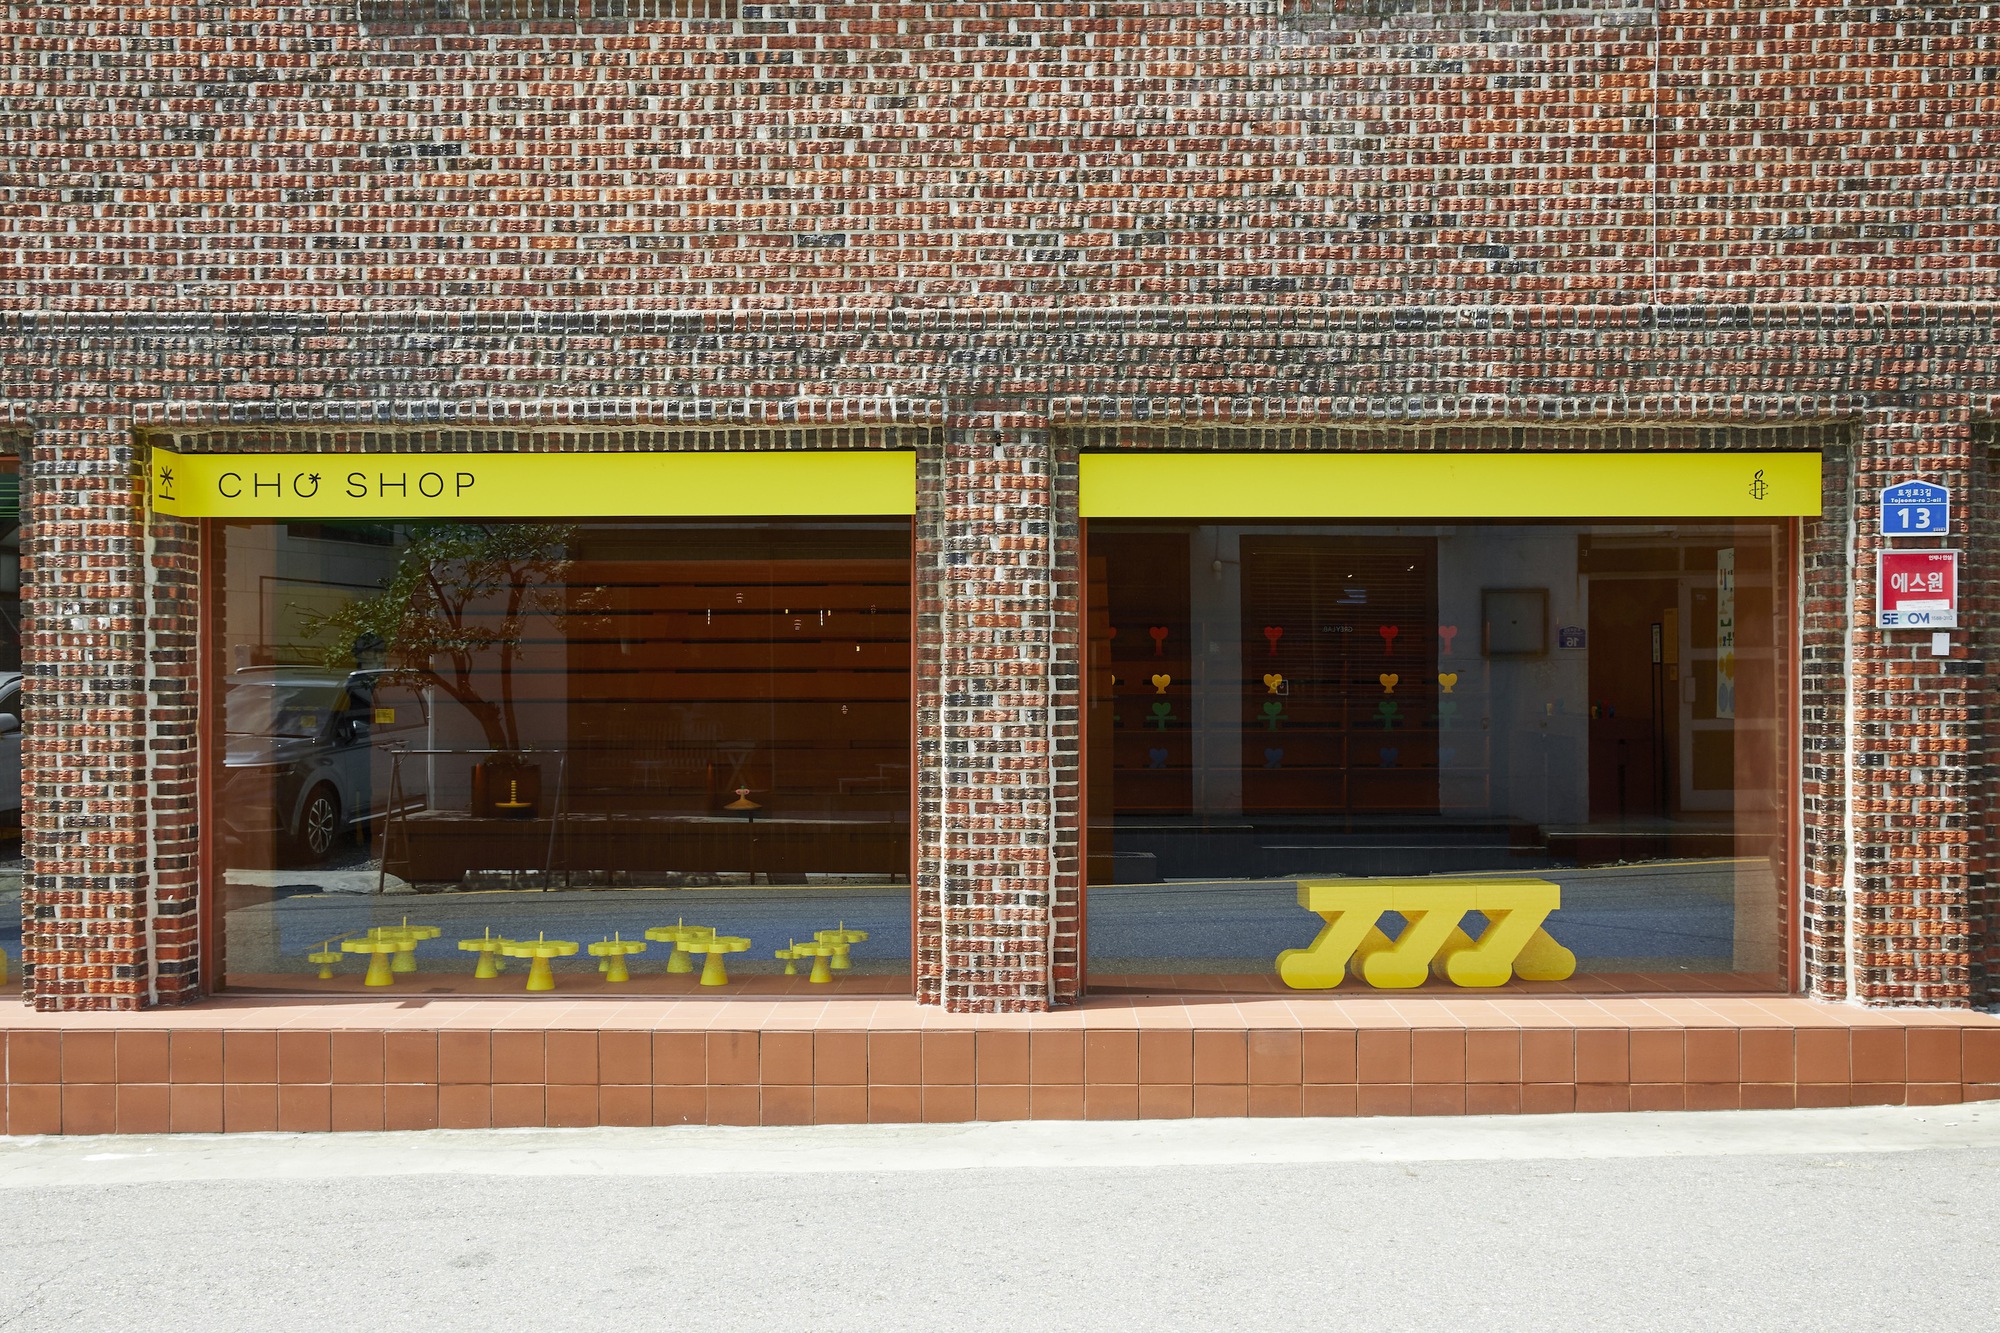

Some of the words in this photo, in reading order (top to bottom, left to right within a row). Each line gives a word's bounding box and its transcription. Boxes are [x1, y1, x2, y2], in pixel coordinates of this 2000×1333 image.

[218, 472, 321, 498] CHO
[346, 472, 475, 498] SHOP
[1897, 488, 1932, 498] 토정로3길
[1897, 508, 1931, 529] 13
[1891, 572, 1943, 593] 에스원
[1882, 612, 1930, 625] SECOM
